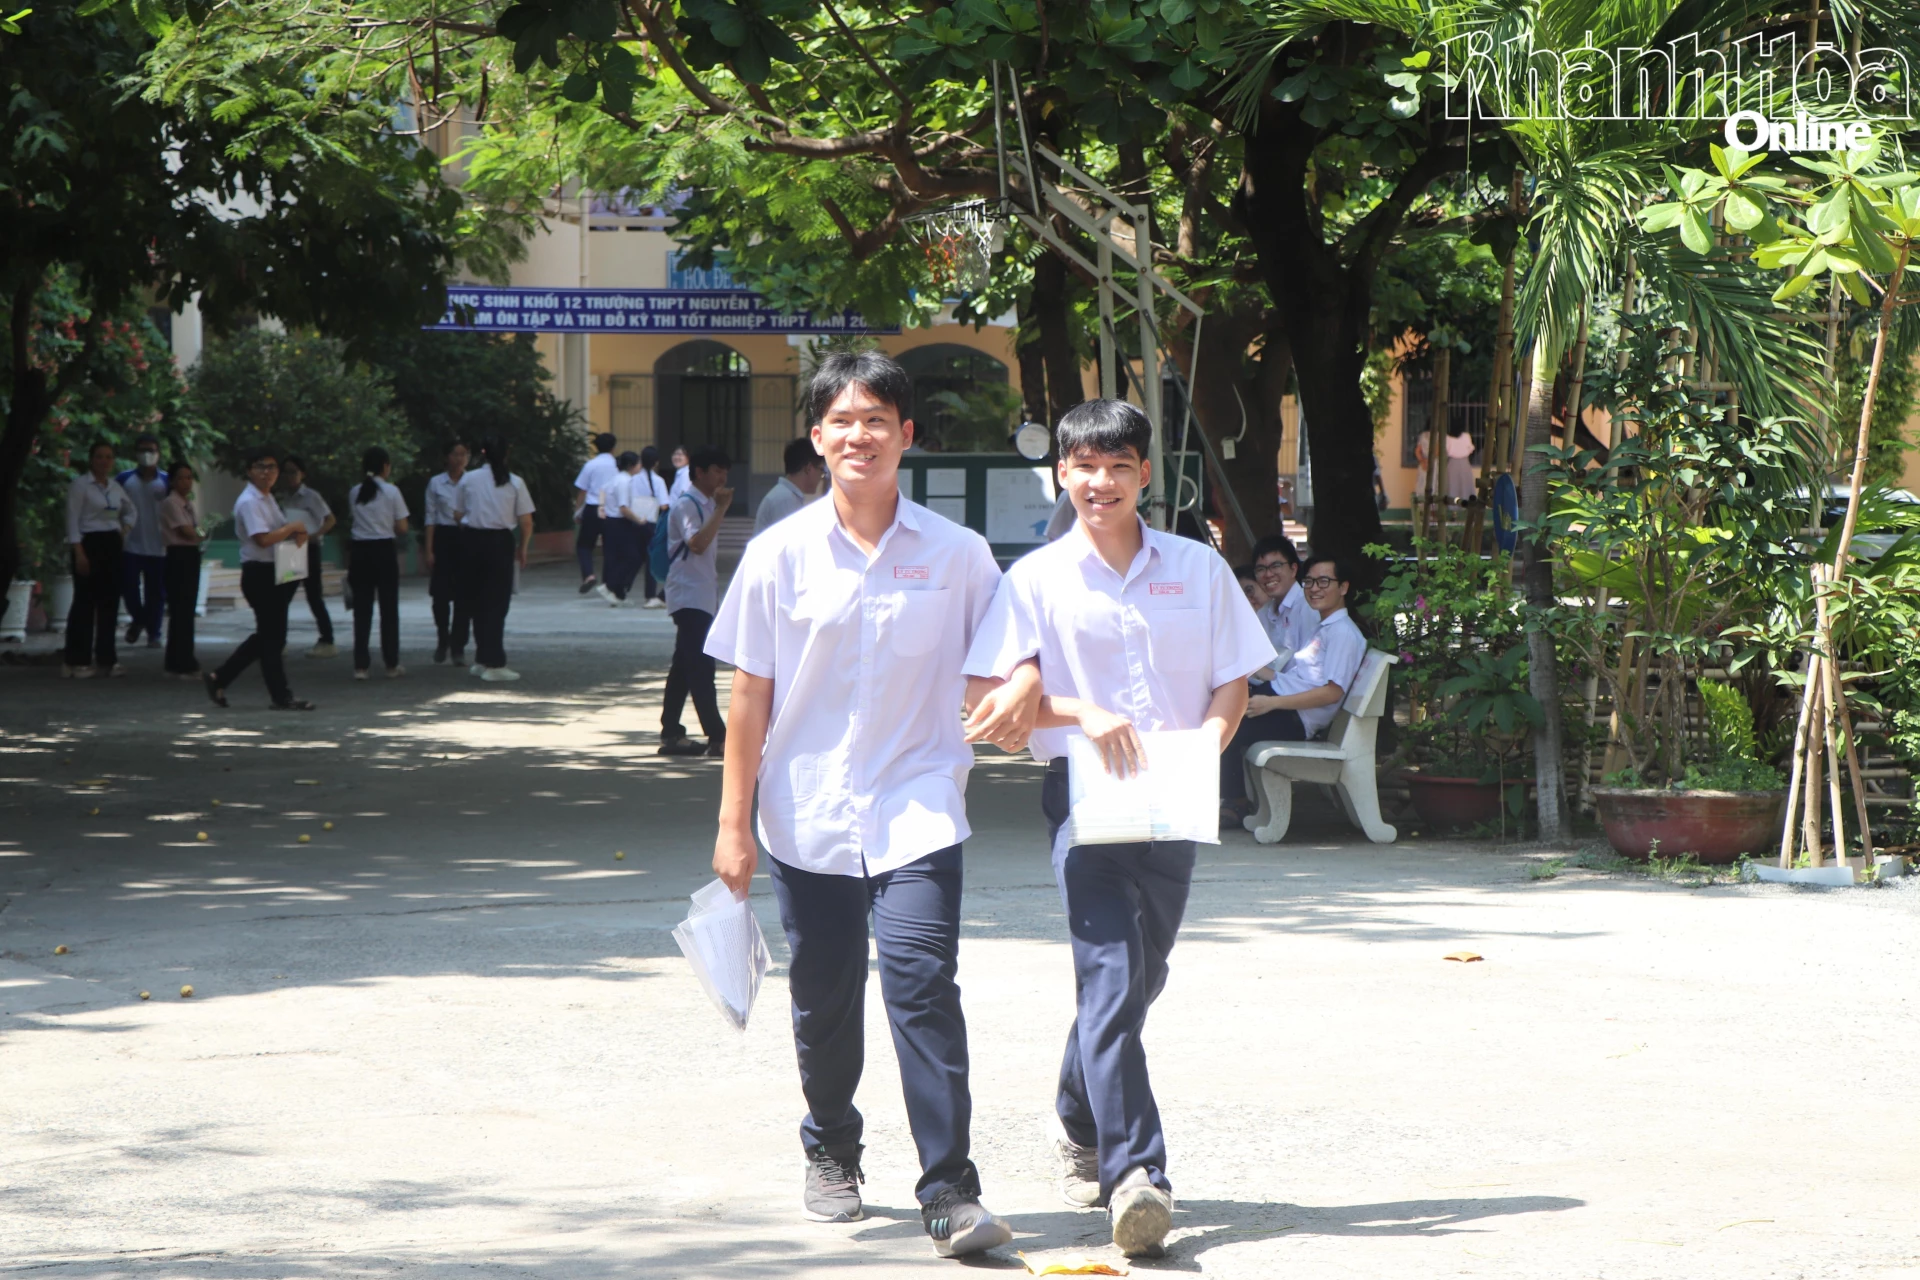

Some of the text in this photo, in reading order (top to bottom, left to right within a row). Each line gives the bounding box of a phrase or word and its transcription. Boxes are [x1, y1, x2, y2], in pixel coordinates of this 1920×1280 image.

[483, 294, 520, 309] SINH
[523, 292, 559, 309] KHỐI
[563, 297, 582, 310] 12
[586, 294, 645, 310] TRƯỜNG
[649, 297, 684, 310] THPT
[689, 294, 749, 310] NGUYỄN
[496, 311, 519, 326] ÔN
[522, 311, 551, 329] TẬP
[554, 311, 574, 327] VÀ
[577, 313, 601, 327] THI
[604, 310, 625, 327] ĐỖ
[629, 312, 648, 327] KỲ
[653, 313, 676, 327] THI
[680, 311, 707, 328] TỐT
[710, 312, 766, 330] NGHIỆP
[770, 314, 807, 328] THPT
